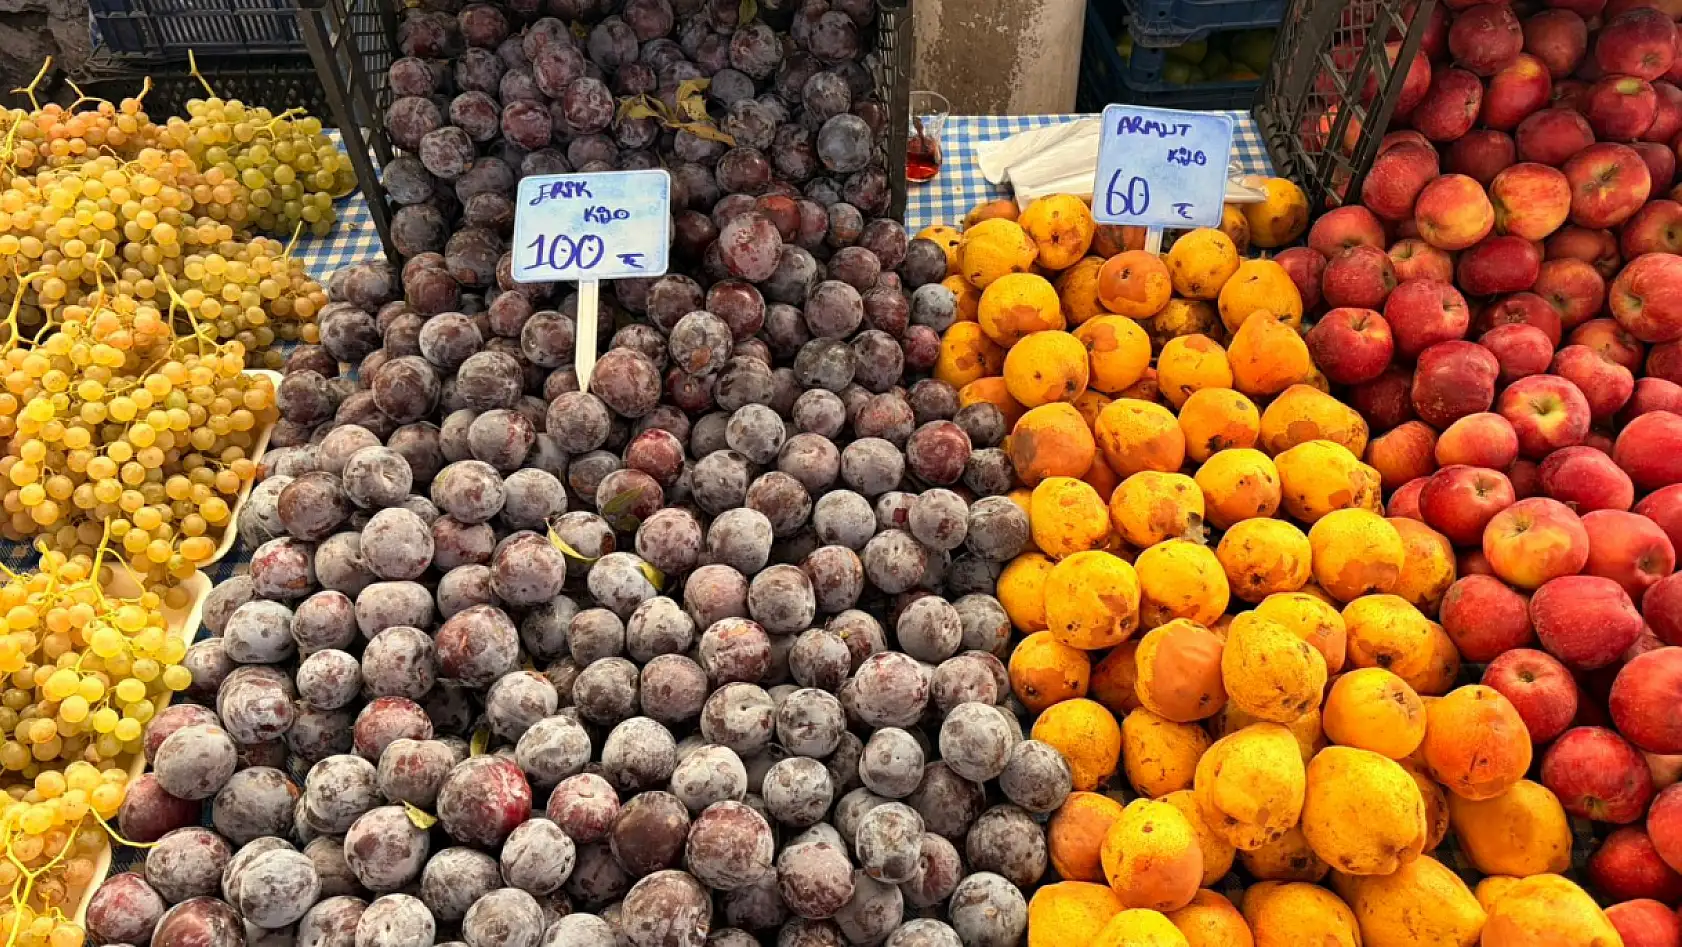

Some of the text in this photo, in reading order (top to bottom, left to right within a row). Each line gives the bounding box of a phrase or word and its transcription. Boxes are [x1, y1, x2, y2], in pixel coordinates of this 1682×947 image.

[1116, 115, 1192, 138] ARMUT
[1106, 168, 1150, 216] 60
[524, 234, 605, 270] 100
